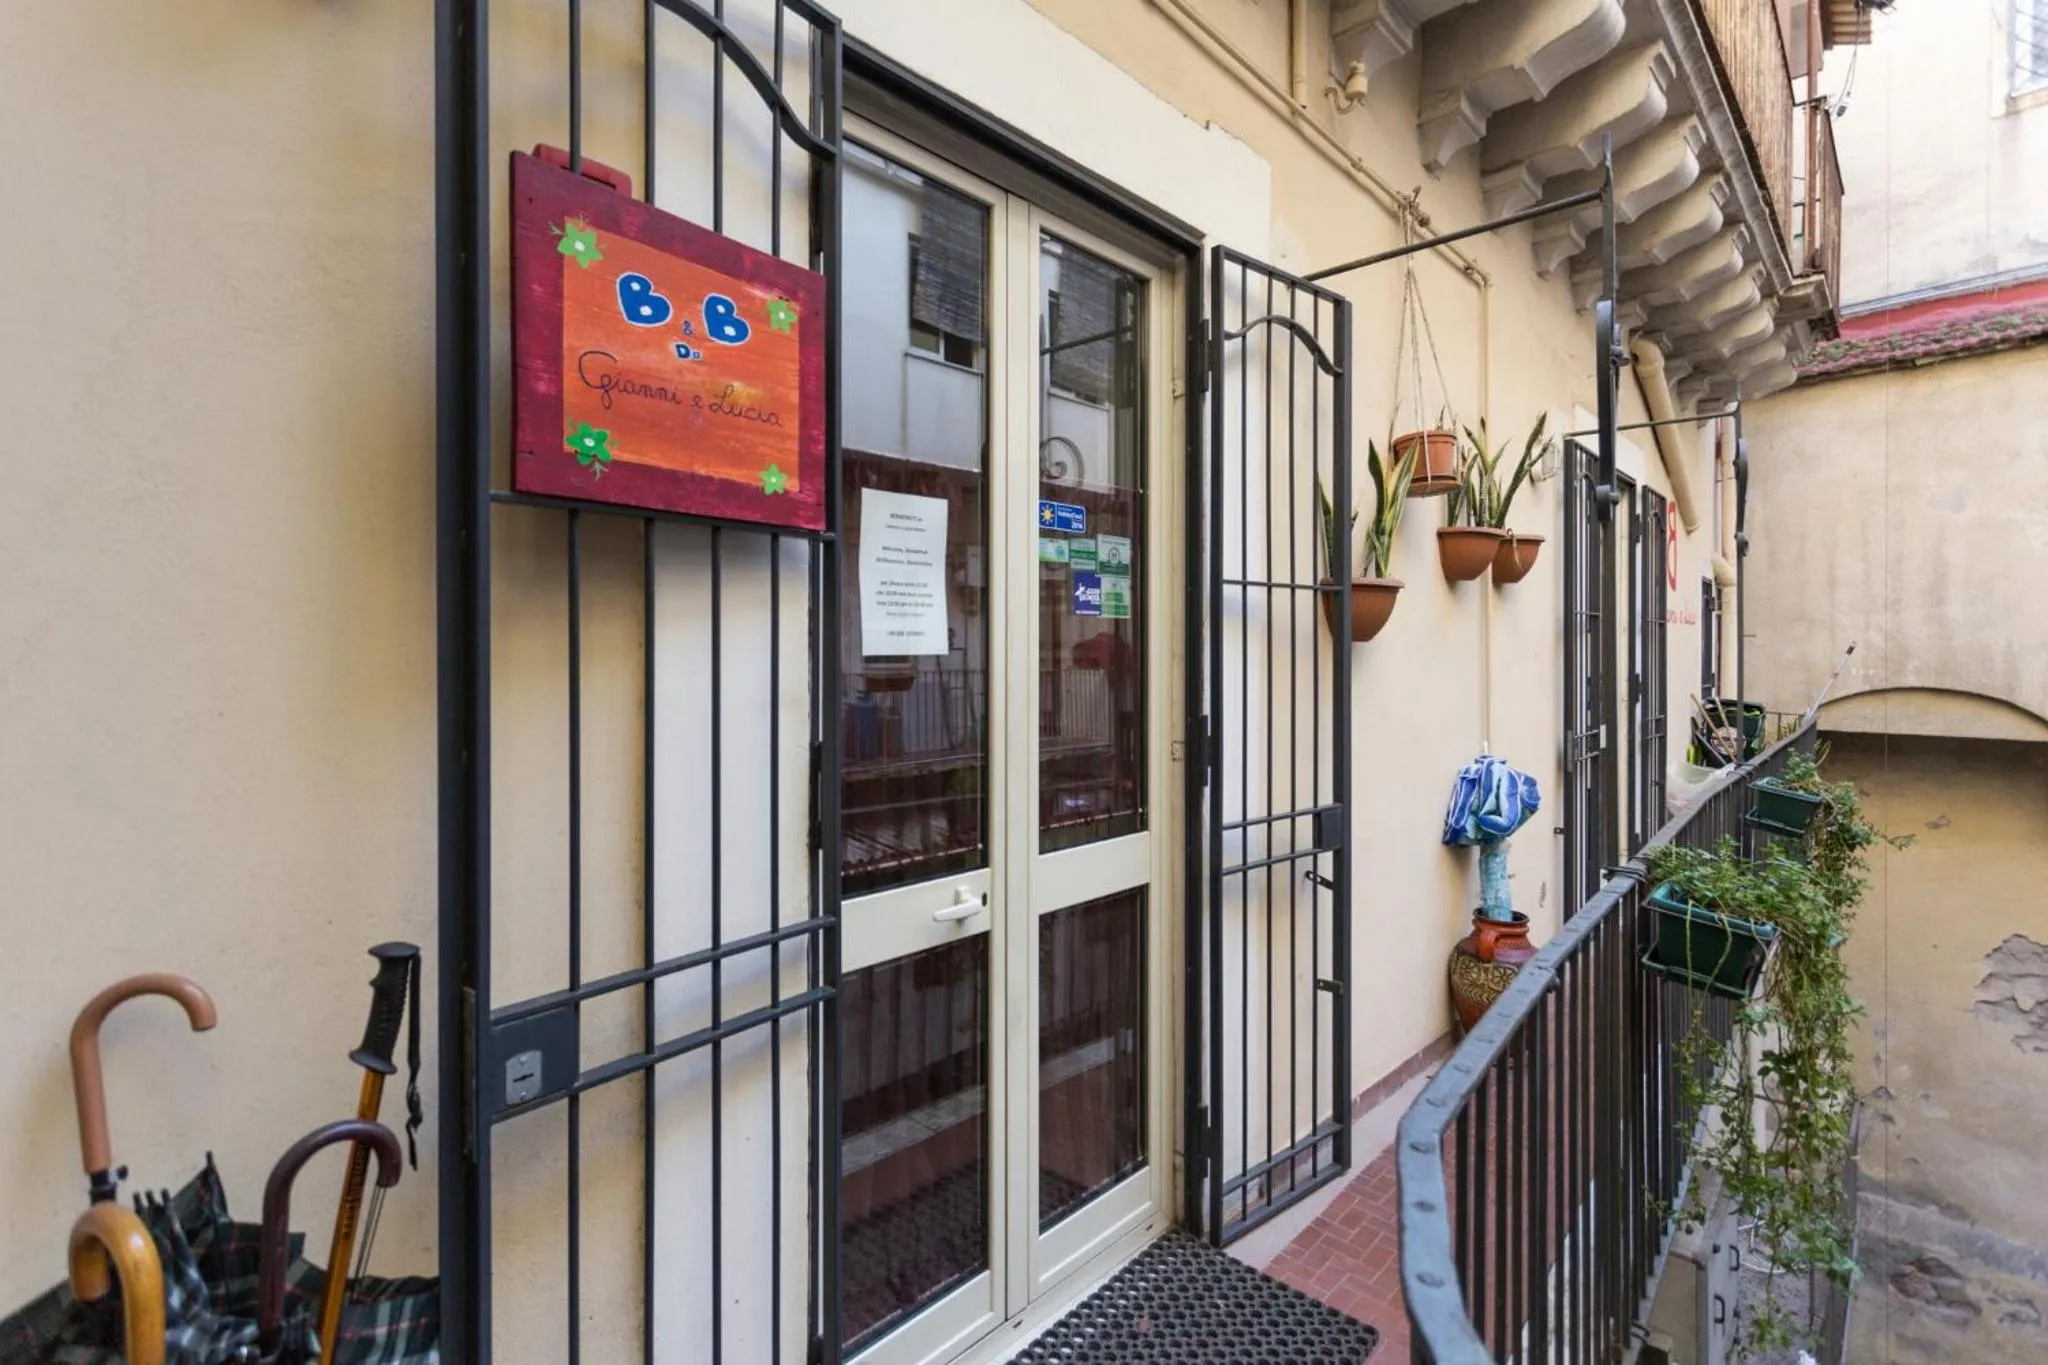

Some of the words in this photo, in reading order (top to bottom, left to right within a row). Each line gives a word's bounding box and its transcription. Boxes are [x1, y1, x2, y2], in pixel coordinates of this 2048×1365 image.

[616, 271, 673, 327] B
[703, 292, 751, 345] B
[578, 350, 682, 411] Gianni
[709, 384, 784, 428] Lucia
